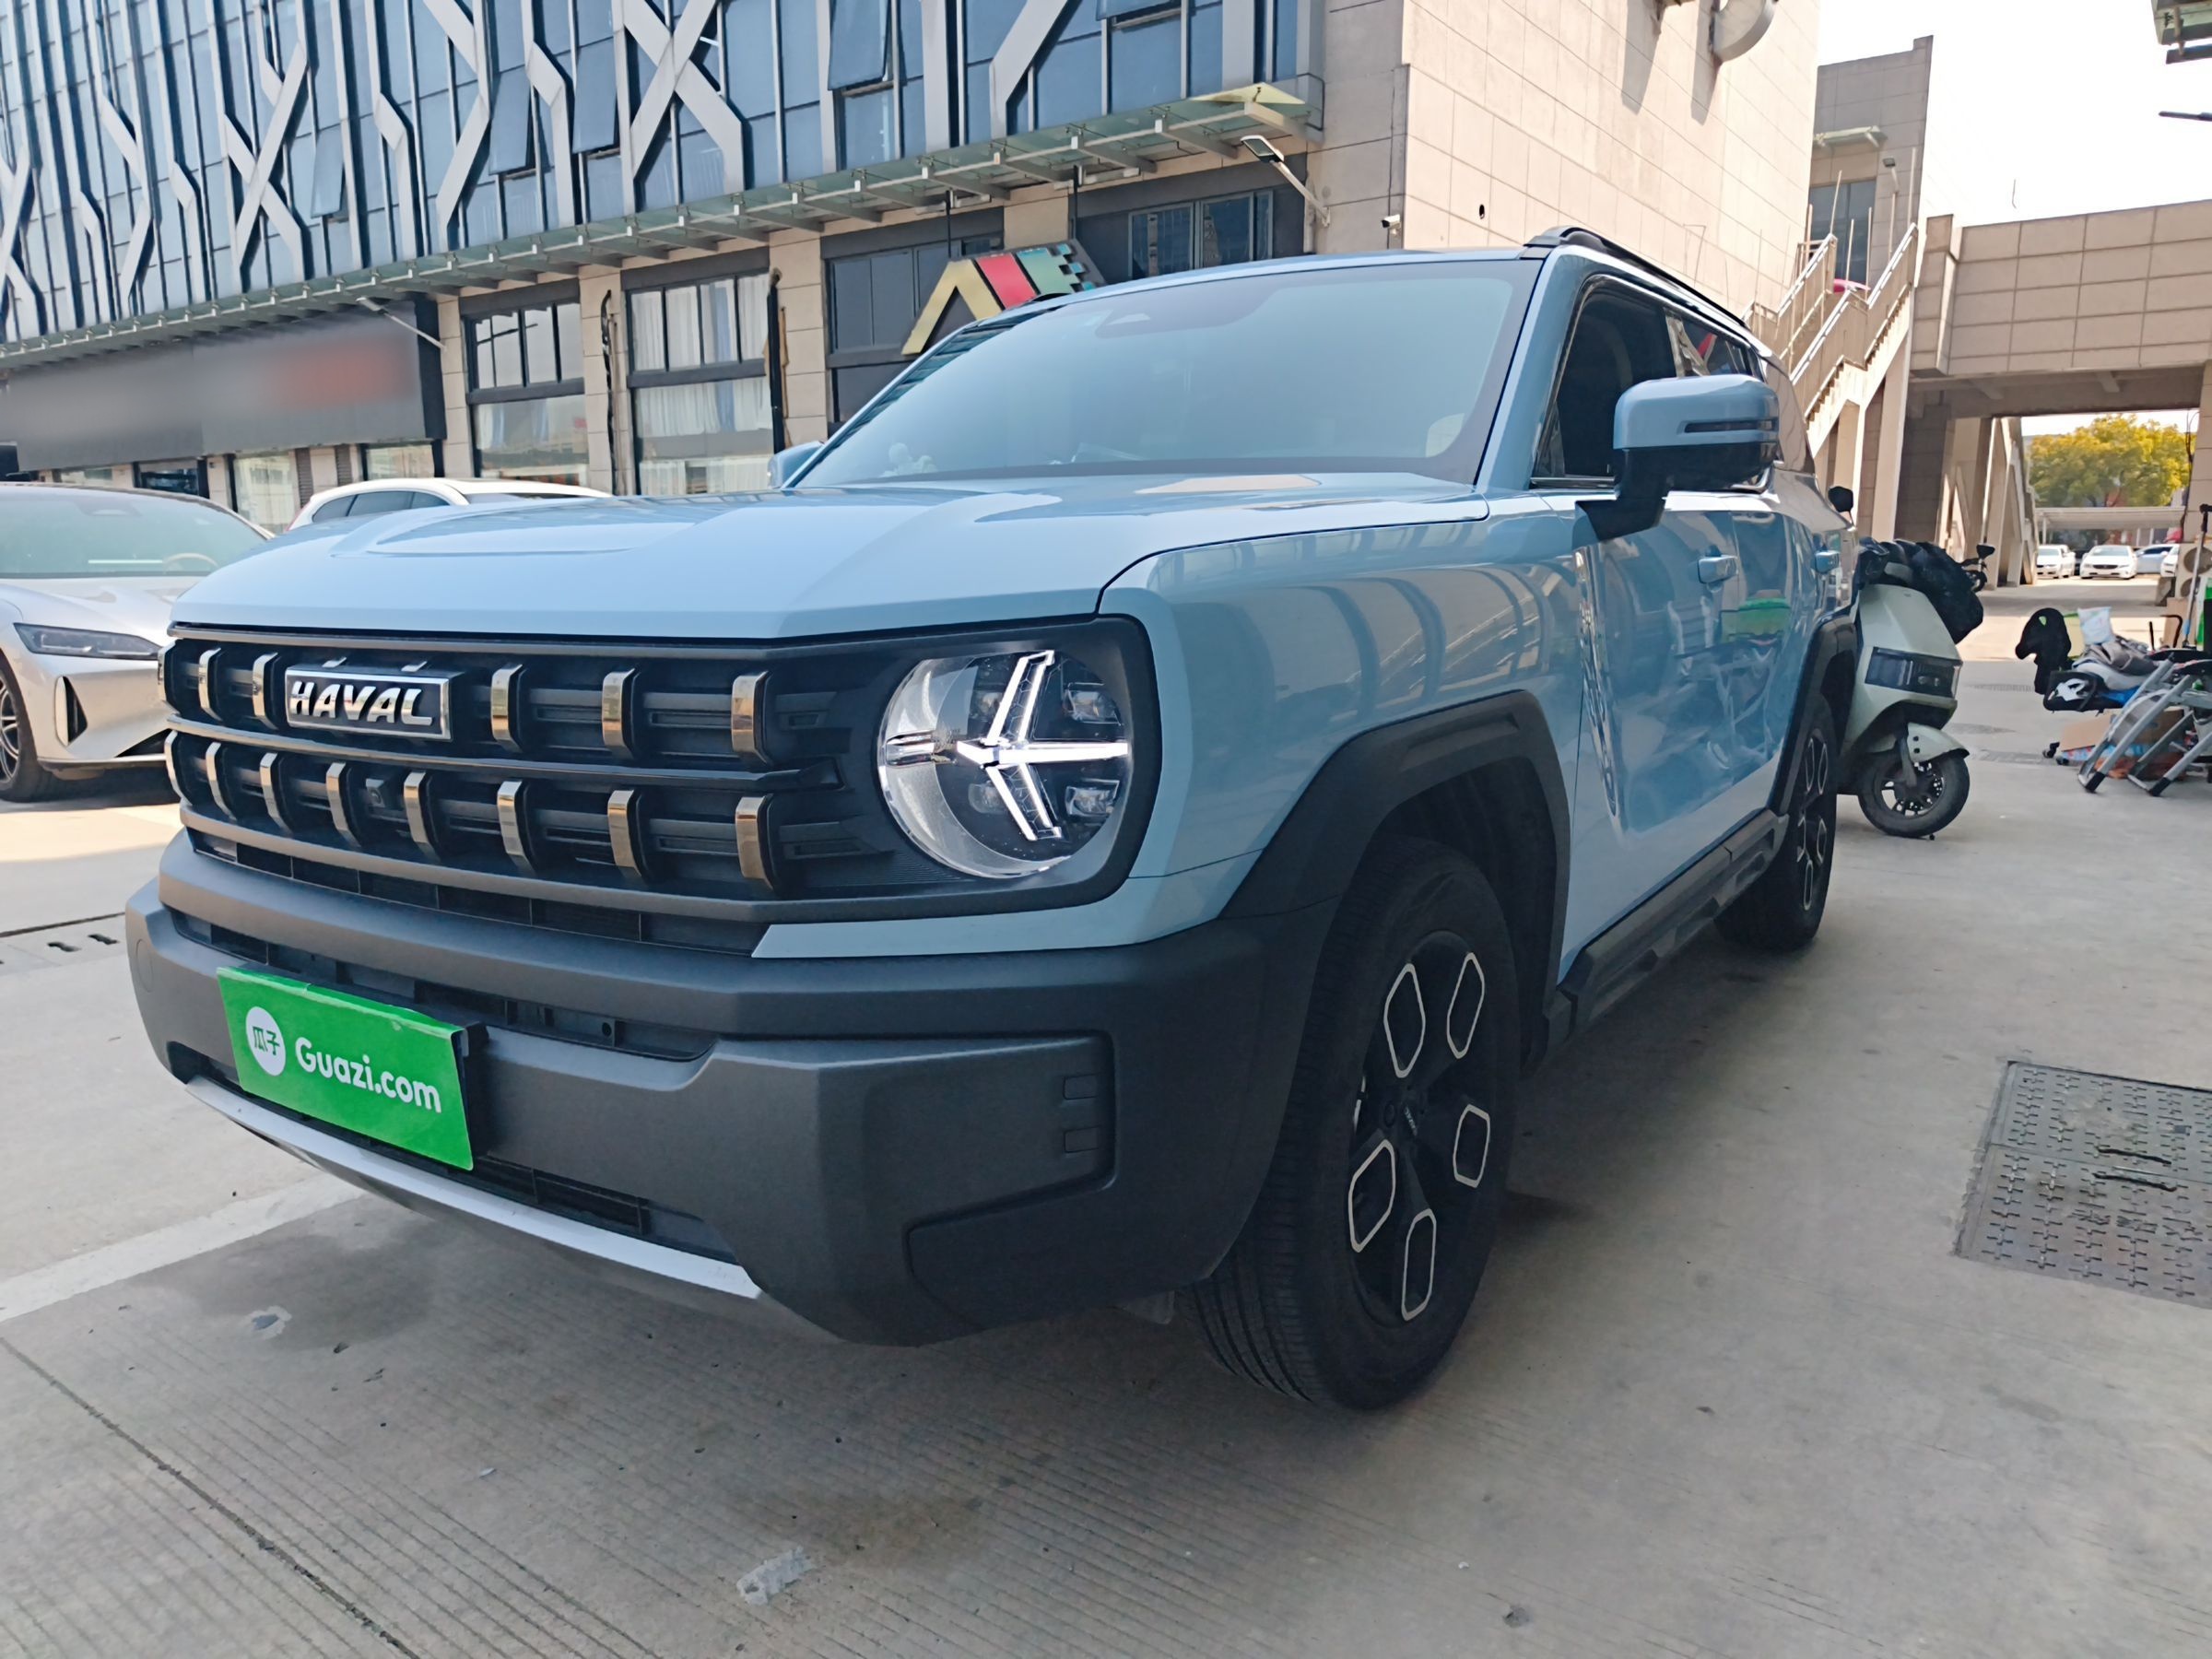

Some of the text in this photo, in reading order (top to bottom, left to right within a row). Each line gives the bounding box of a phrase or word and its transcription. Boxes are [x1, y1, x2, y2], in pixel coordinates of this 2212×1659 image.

[289, 680, 432, 726] HAVAL
[253, 1026, 280, 1055] 瓜子
[295, 1037, 441, 1113] Guazi.com
